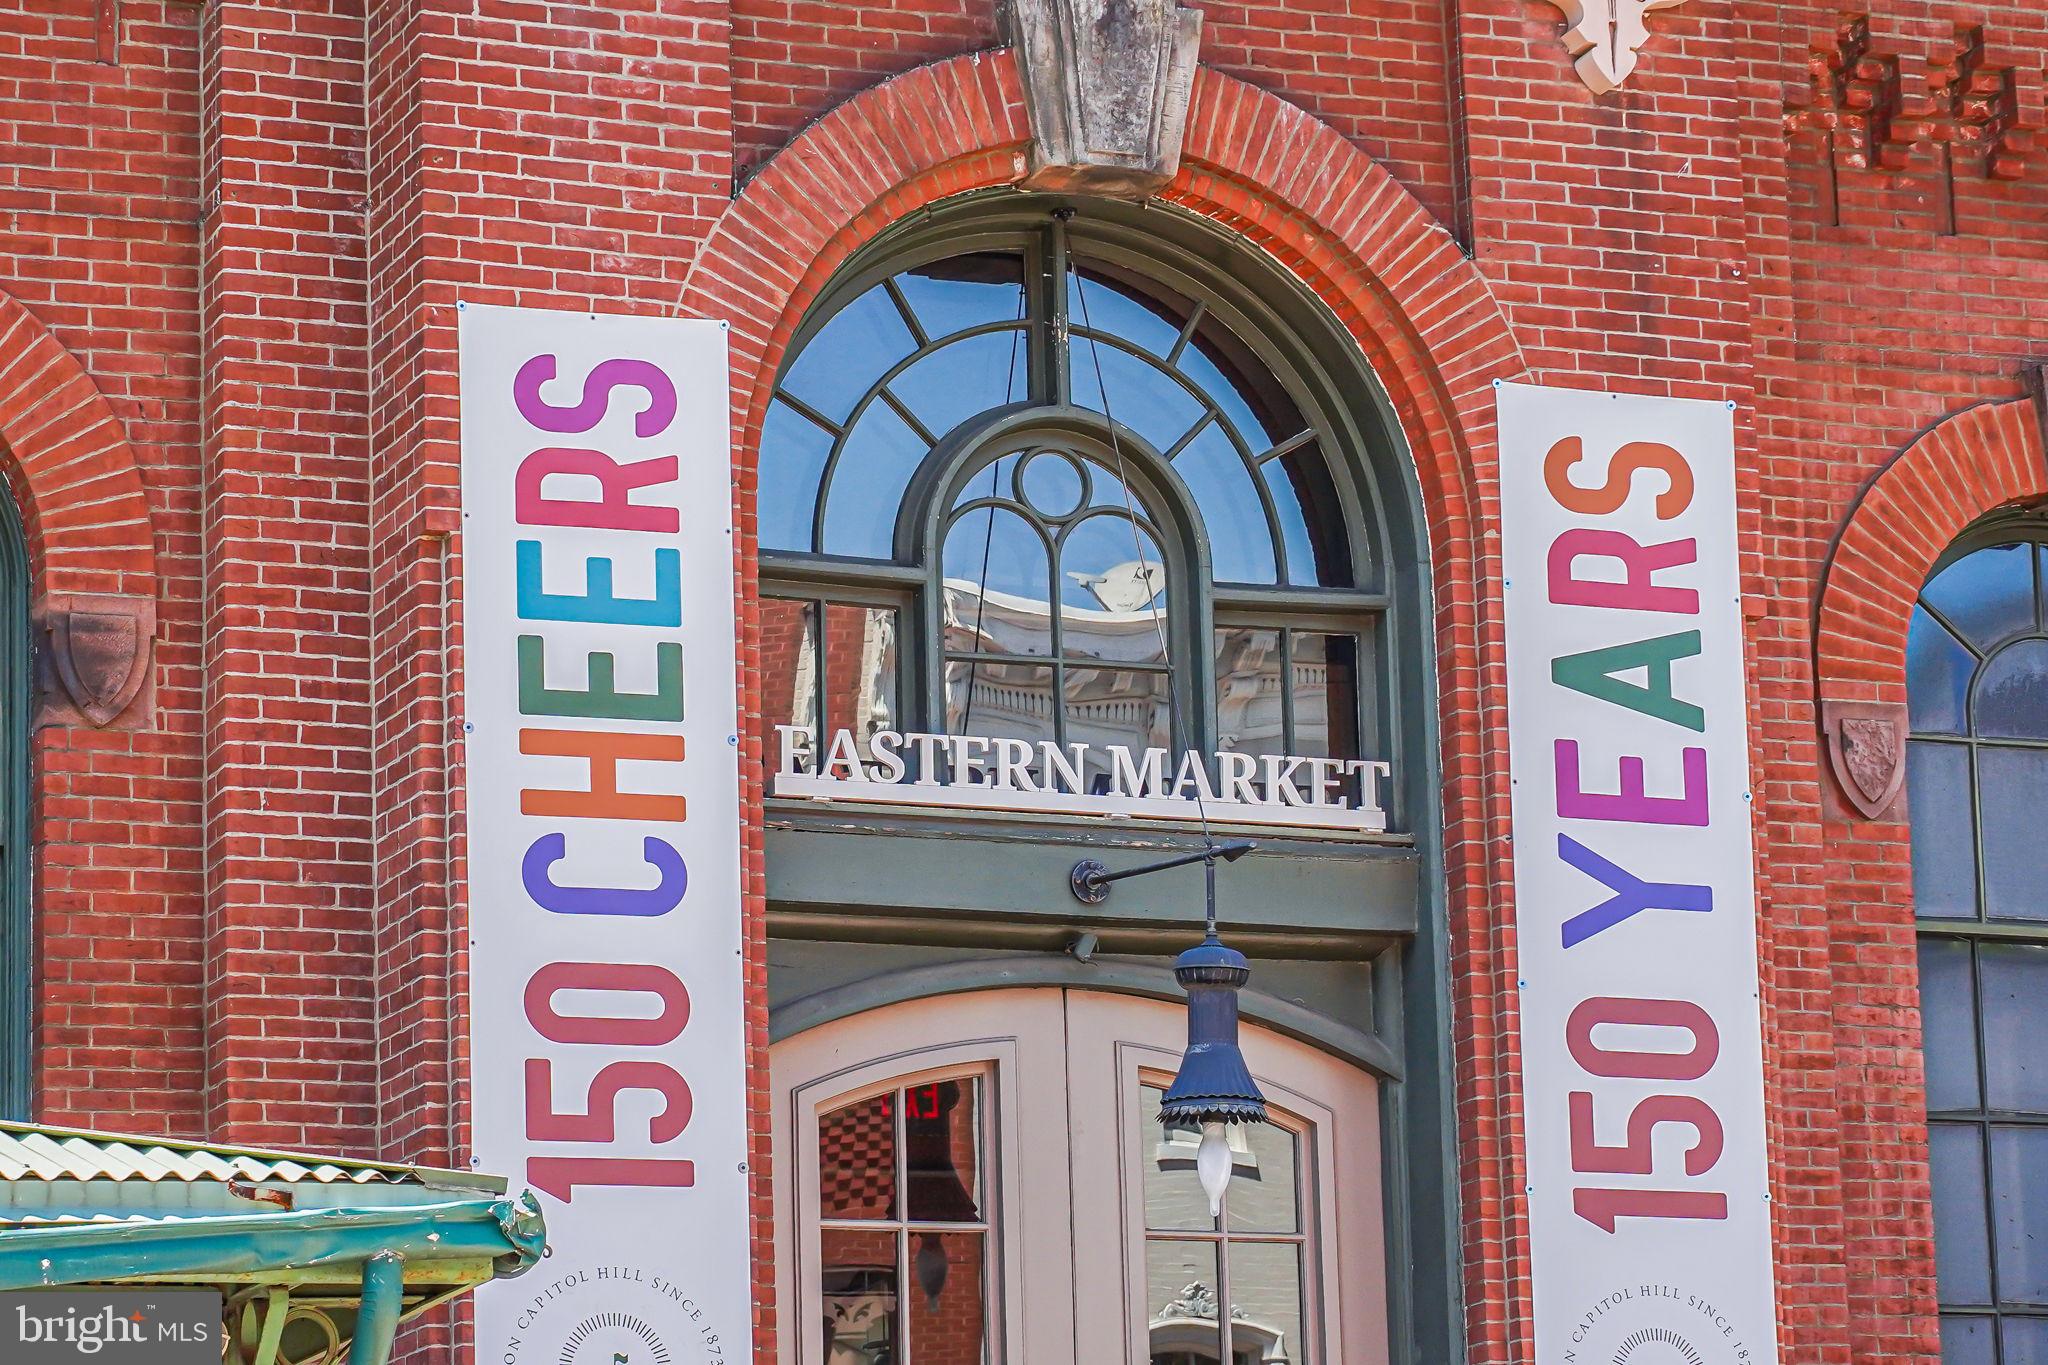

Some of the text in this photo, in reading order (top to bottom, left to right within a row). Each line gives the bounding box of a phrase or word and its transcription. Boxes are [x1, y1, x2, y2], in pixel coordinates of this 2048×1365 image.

[513, 353, 695, 1204] 150 CHEERS
[773, 724, 1390, 813] EASTERN MARKET
[1544, 435, 1729, 1235] 150 YEARS
[503, 1336, 521, 1365] ON
[517, 1270, 589, 1330] CAPITOL
[597, 1266, 643, 1282] HILL
[651, 1277, 702, 1322] SINCE
[1572, 1288, 1633, 1343] CAPITOL
[1640, 1284, 1681, 1300] HILL
[1687, 1294, 1734, 1338] SINCE
